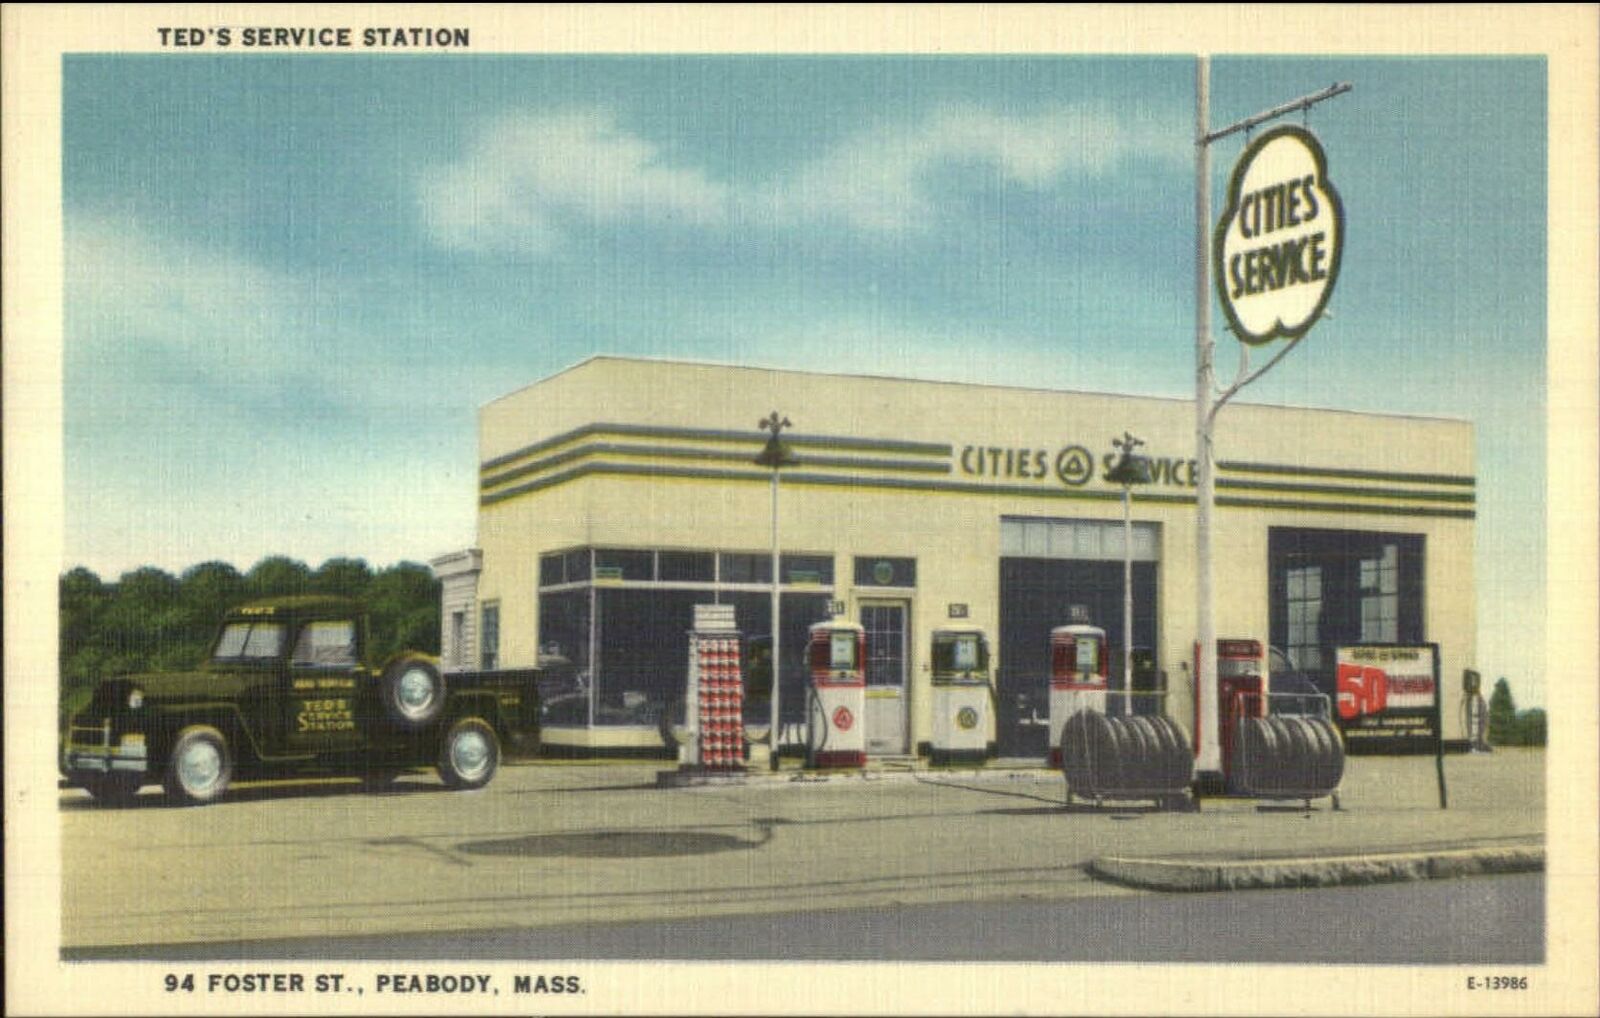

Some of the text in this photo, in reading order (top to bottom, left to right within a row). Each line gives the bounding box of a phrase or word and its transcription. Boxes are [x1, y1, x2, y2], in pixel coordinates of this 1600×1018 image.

[1239, 174, 1319, 240] CITIES
[1229, 232, 1327, 300] SERVICE
[960, 445, 1199, 487] CITIES SVICE
